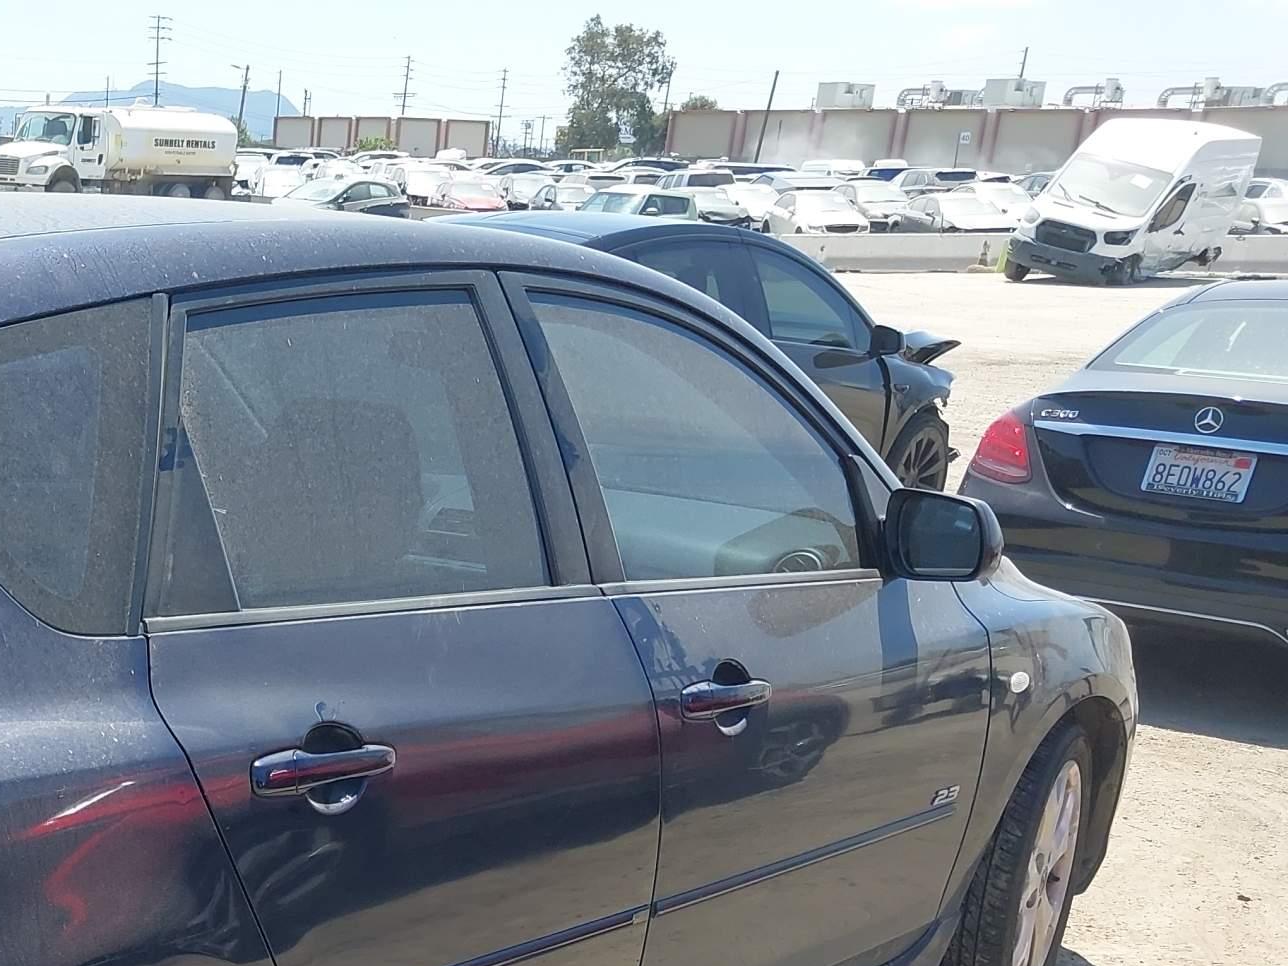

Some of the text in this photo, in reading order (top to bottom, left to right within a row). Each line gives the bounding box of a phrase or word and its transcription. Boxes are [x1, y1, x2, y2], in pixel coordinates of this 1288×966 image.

[154, 138, 216, 149] SUNBELT RENTALS
[1041, 408, 1080, 419] C300
[1158, 449, 1172, 457] OCT
[1152, 463, 1242, 493] 8EDW862
